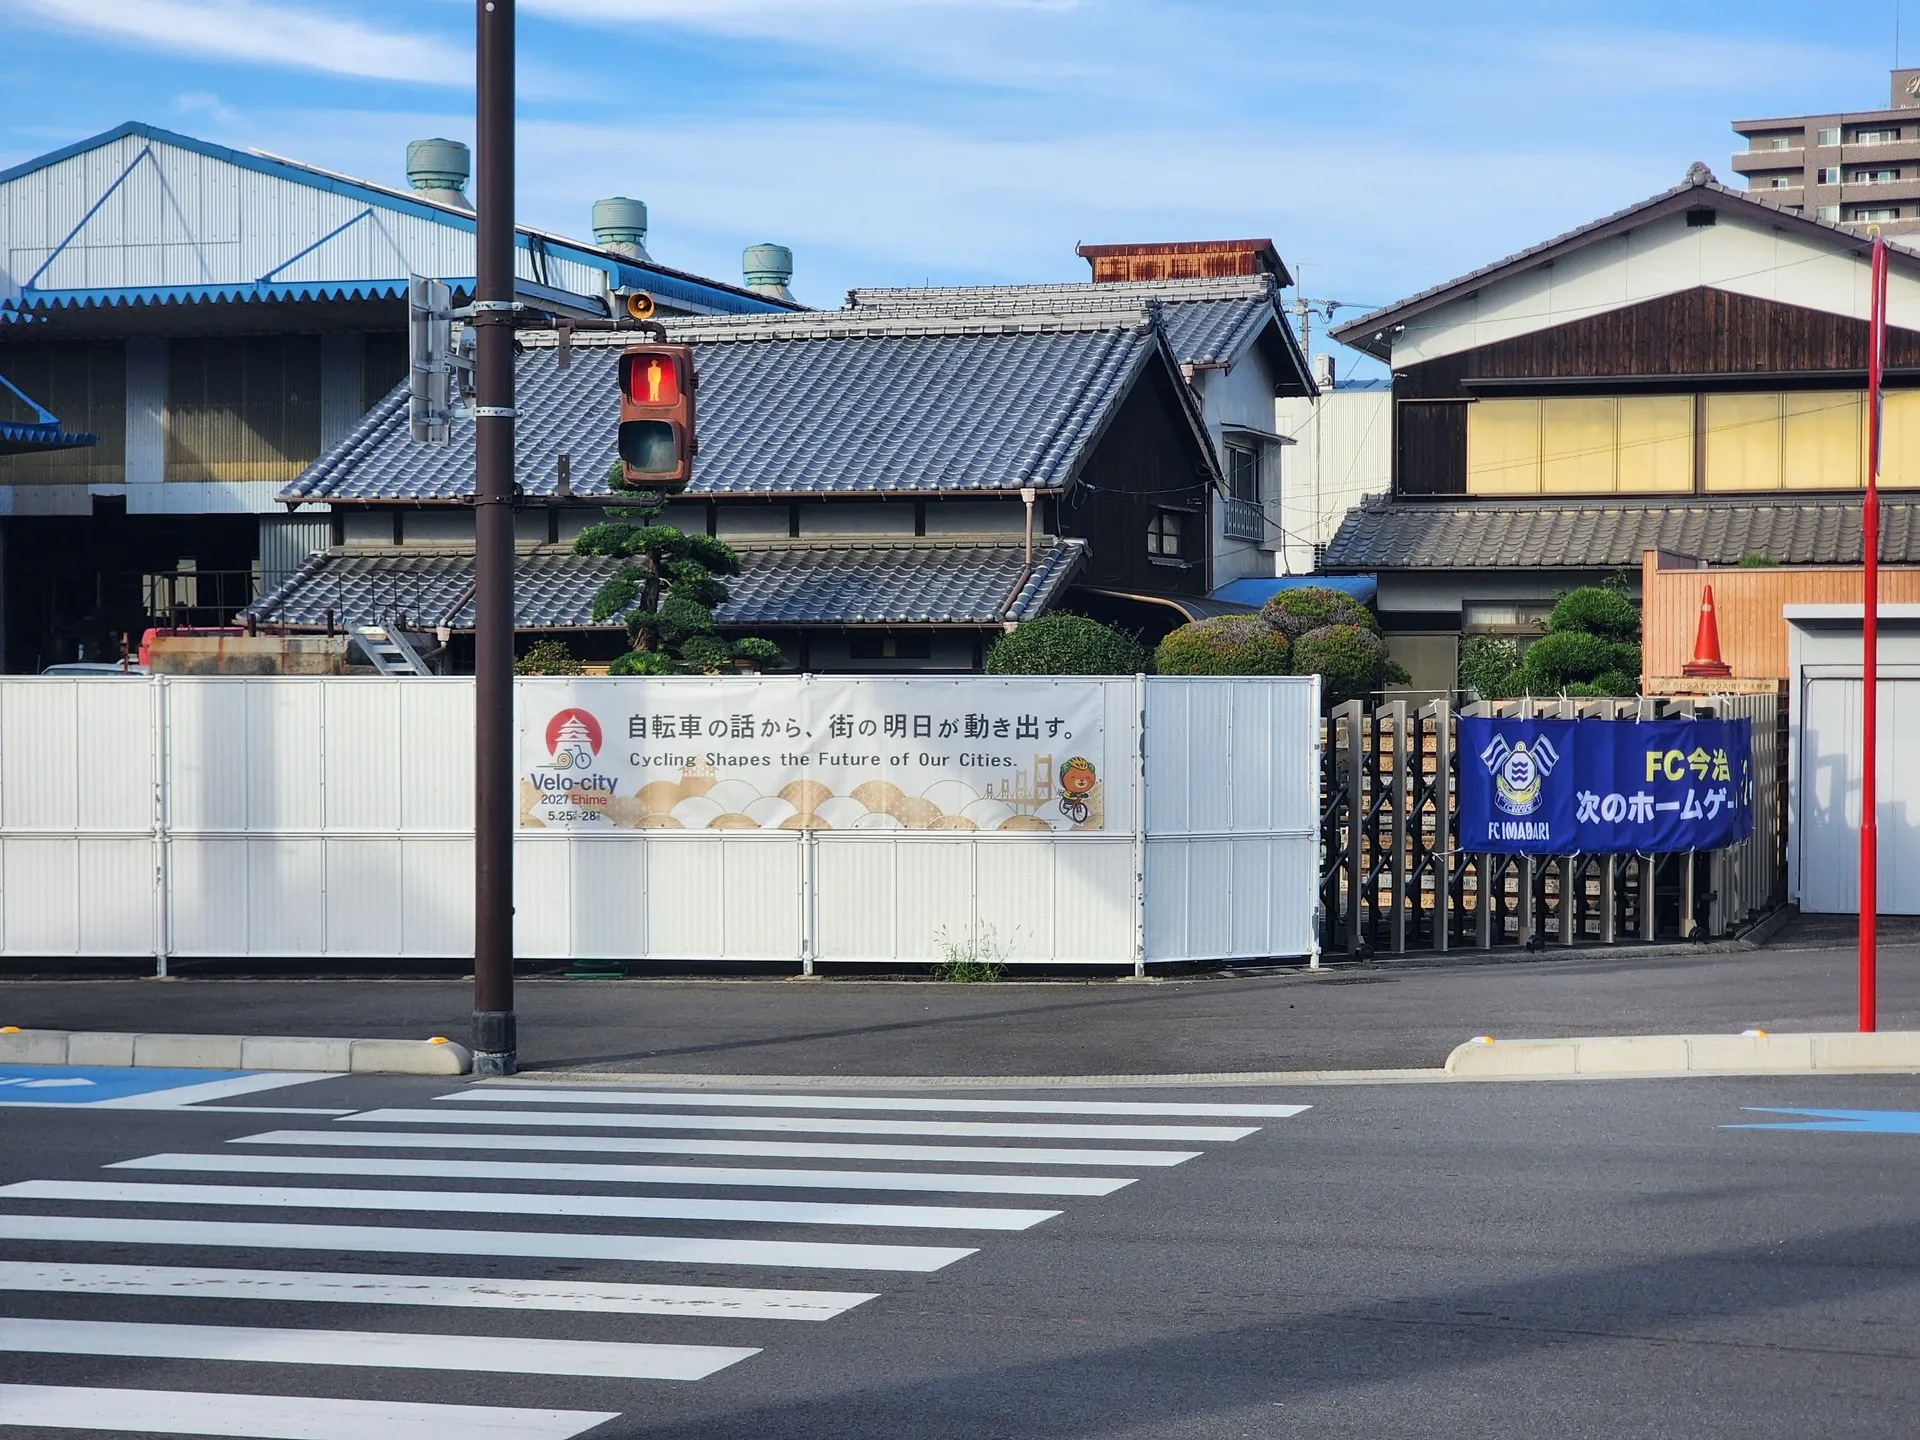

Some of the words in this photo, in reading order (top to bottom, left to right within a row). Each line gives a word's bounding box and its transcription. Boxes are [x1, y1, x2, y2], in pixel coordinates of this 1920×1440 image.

[628, 713, 1073, 740] 自転車の話から、街の明日が動き出す。
[630, 752, 696, 768] Cycling
[707, 752, 771, 767] Shapes
[780, 752, 810, 766] the
[819, 752, 880, 766] Future
[890, 752, 910, 766] of
[919, 752, 950, 767] Our
[959, 752, 1018, 767] Cities.
[1646, 747, 1730, 781] FC今治
[530, 773, 619, 795] Velo-city
[541, 794, 569, 805] 2027
[571, 794, 607, 805] Ehime
[1488, 821, 1501, 840] FC
[1501, 821, 1550, 840] IMABARI
